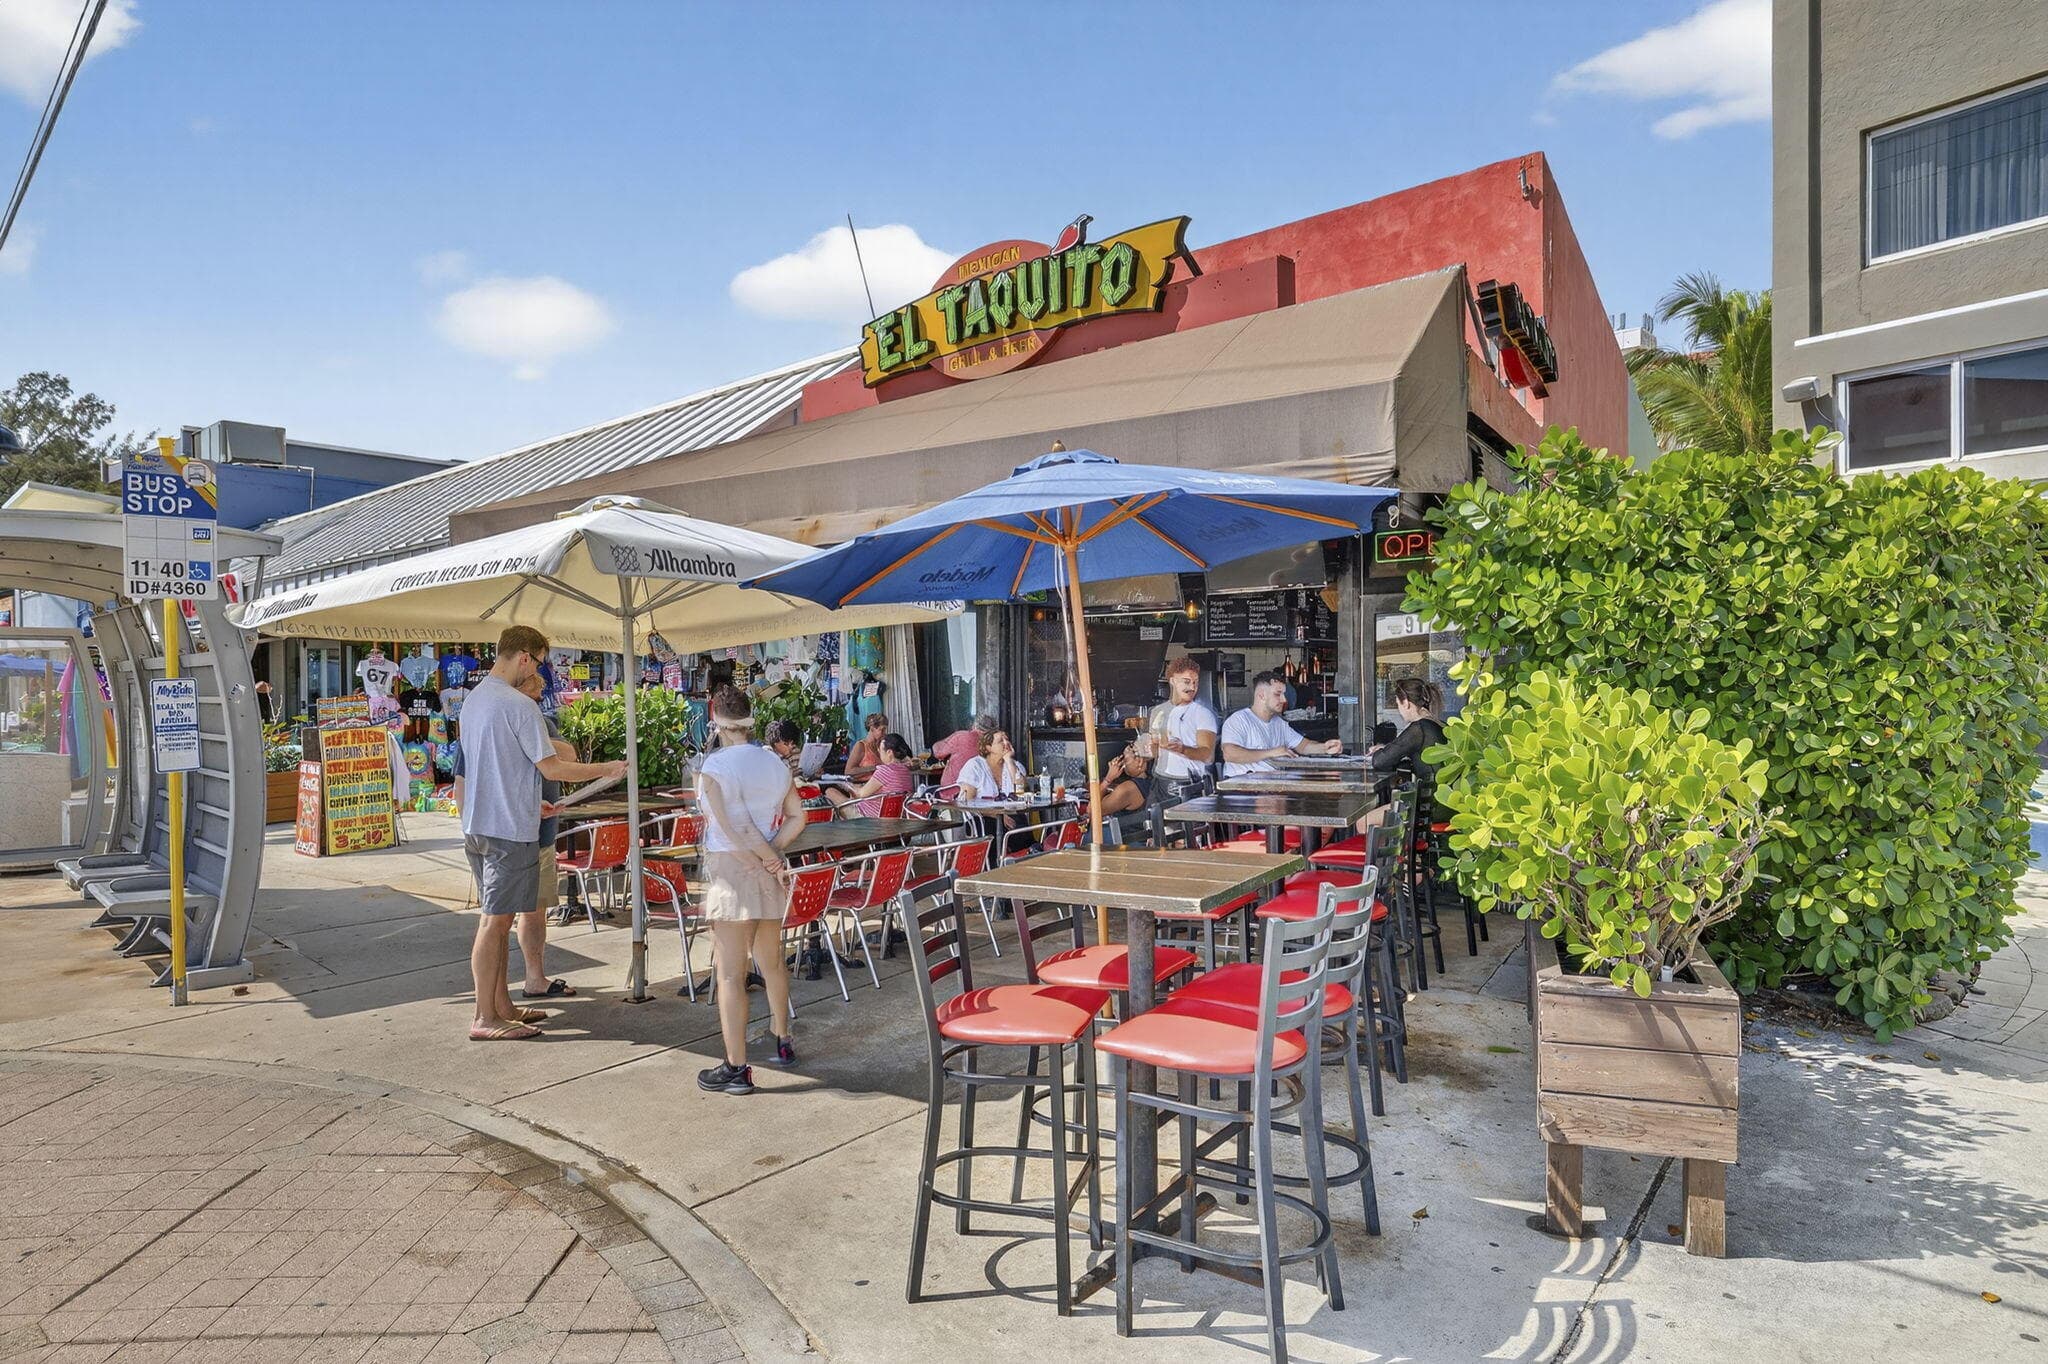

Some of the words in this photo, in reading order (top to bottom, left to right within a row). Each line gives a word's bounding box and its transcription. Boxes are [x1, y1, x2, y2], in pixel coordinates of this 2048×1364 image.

[958, 246, 1021, 279] MEXICAN
[873, 304, 929, 371] EL
[936, 241, 1138, 344] TAQUITO
[127, 473, 178, 495] BUS
[127, 493, 193, 515] STOP
[131, 560, 150, 577] 11
[160, 562, 185, 578] 40
[645, 548, 738, 578] Alhambra
[130, 580, 207, 596] ID#4360
[366, 667, 390, 685] 67
